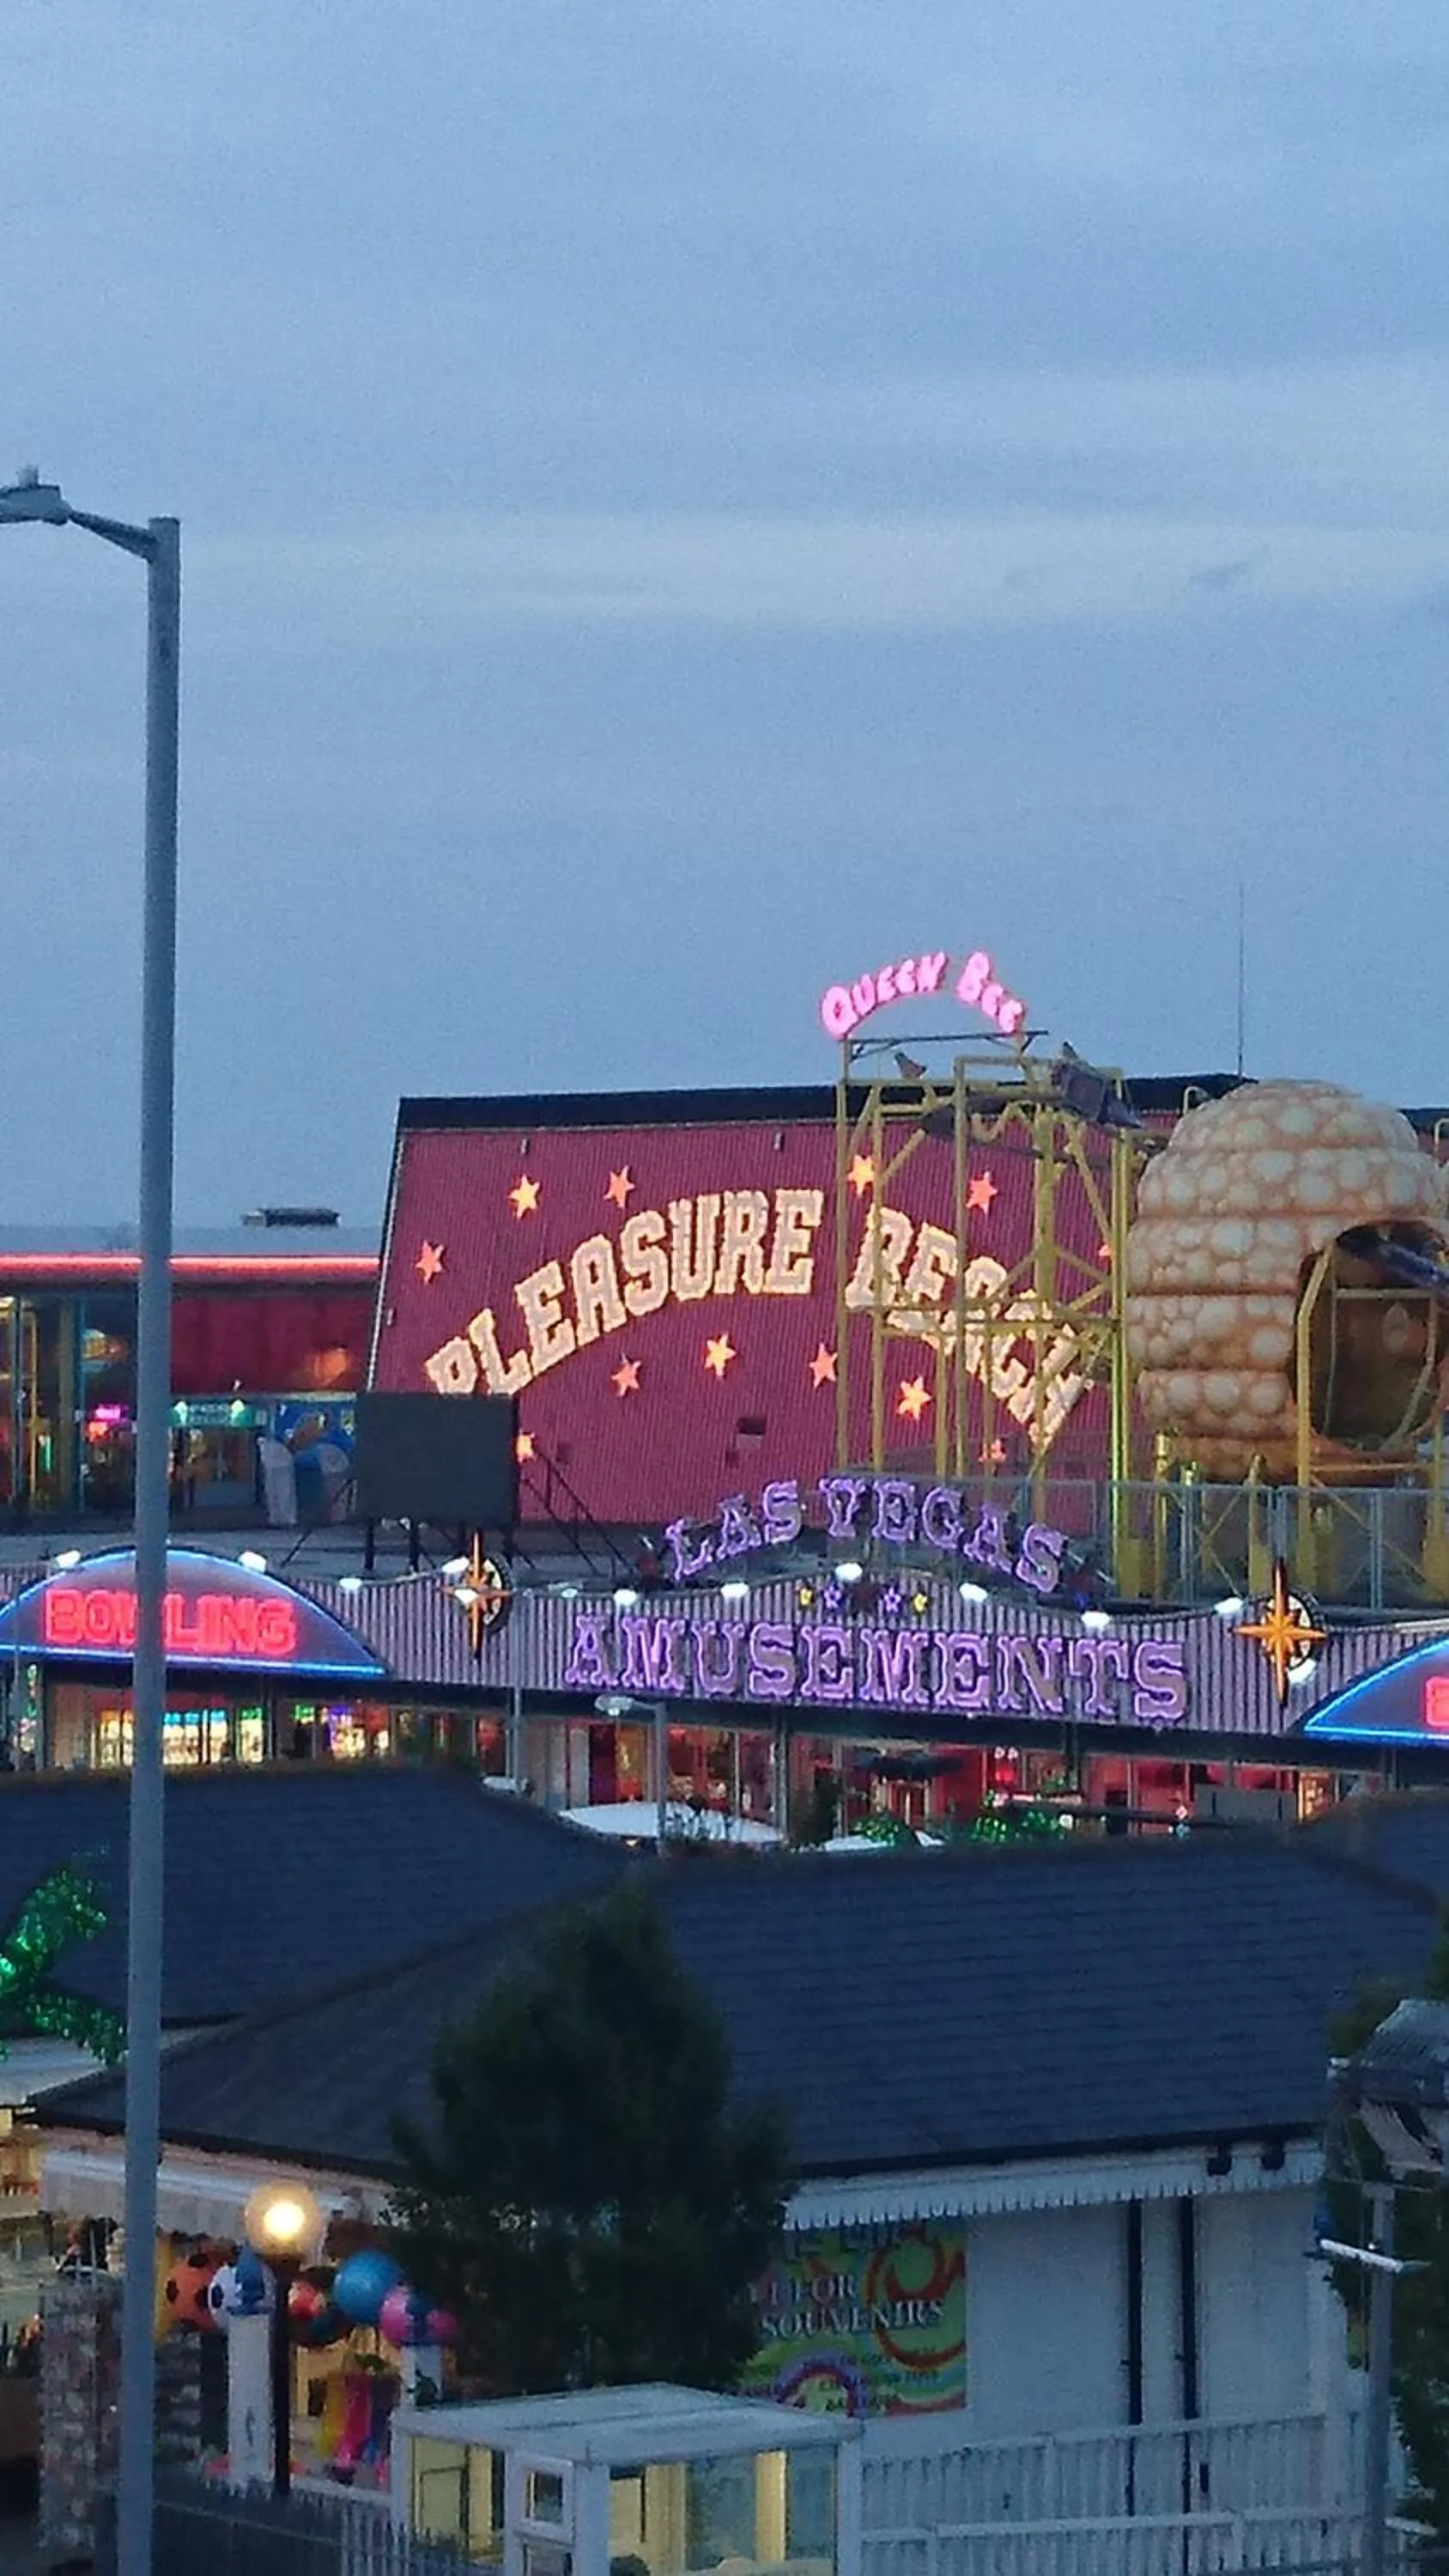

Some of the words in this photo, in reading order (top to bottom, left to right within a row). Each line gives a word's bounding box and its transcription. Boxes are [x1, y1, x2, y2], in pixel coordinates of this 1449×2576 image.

[822, 949, 948, 1040] QUEEN
[955, 950, 1024, 1033] BEE
[425, 1188, 824, 1395] PLEASURE
[664, 1479, 803, 1582] LAS
[818, 1476, 1064, 1594] VEGAS
[565, 1611, 1185, 1721] AMUSEMENTS
[761, 2299, 944, 2339] SOUVENIRS
